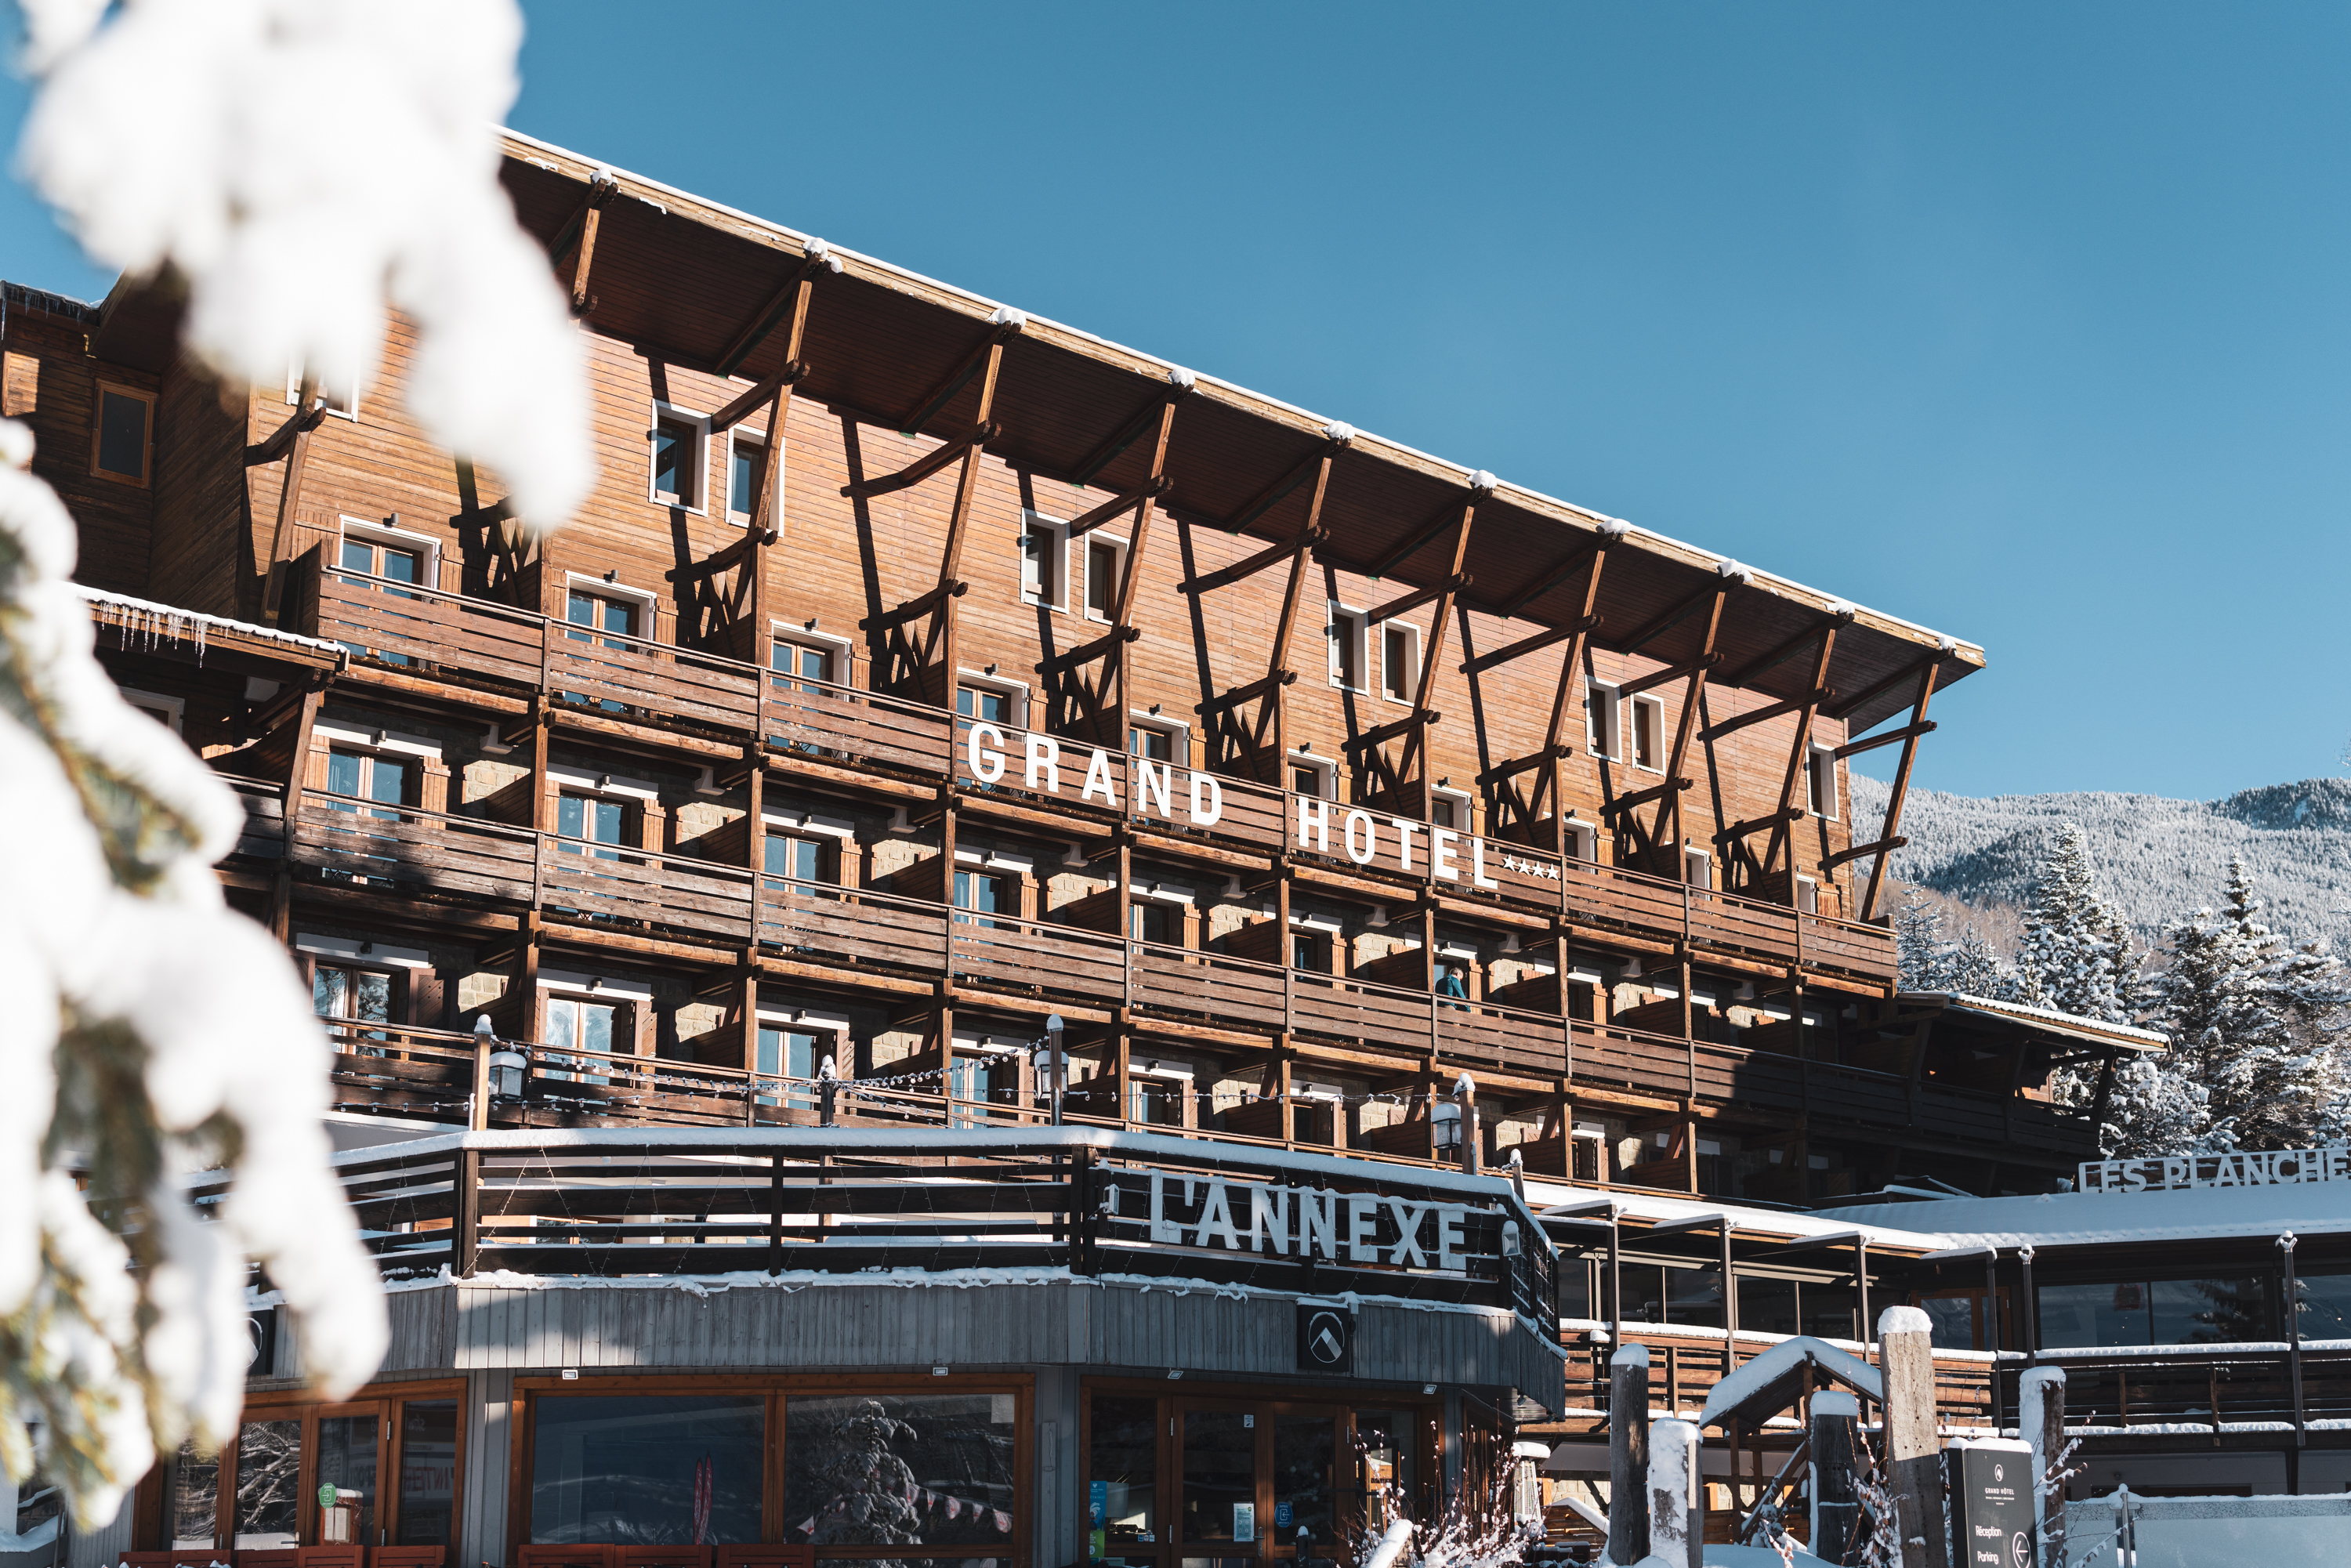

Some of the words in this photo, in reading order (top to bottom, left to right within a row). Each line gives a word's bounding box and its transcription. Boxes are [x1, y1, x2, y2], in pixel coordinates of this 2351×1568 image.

[968, 722, 1223, 827] GRAND
[1297, 795, 1499, 890] HOTEL
[2078, 1162, 2147, 1193] LES
[1150, 1169, 1467, 1271] L'ANNEXE
[1976, 1525, 2002, 1539] Réception
[1977, 1551, 1999, 1565] Parking
